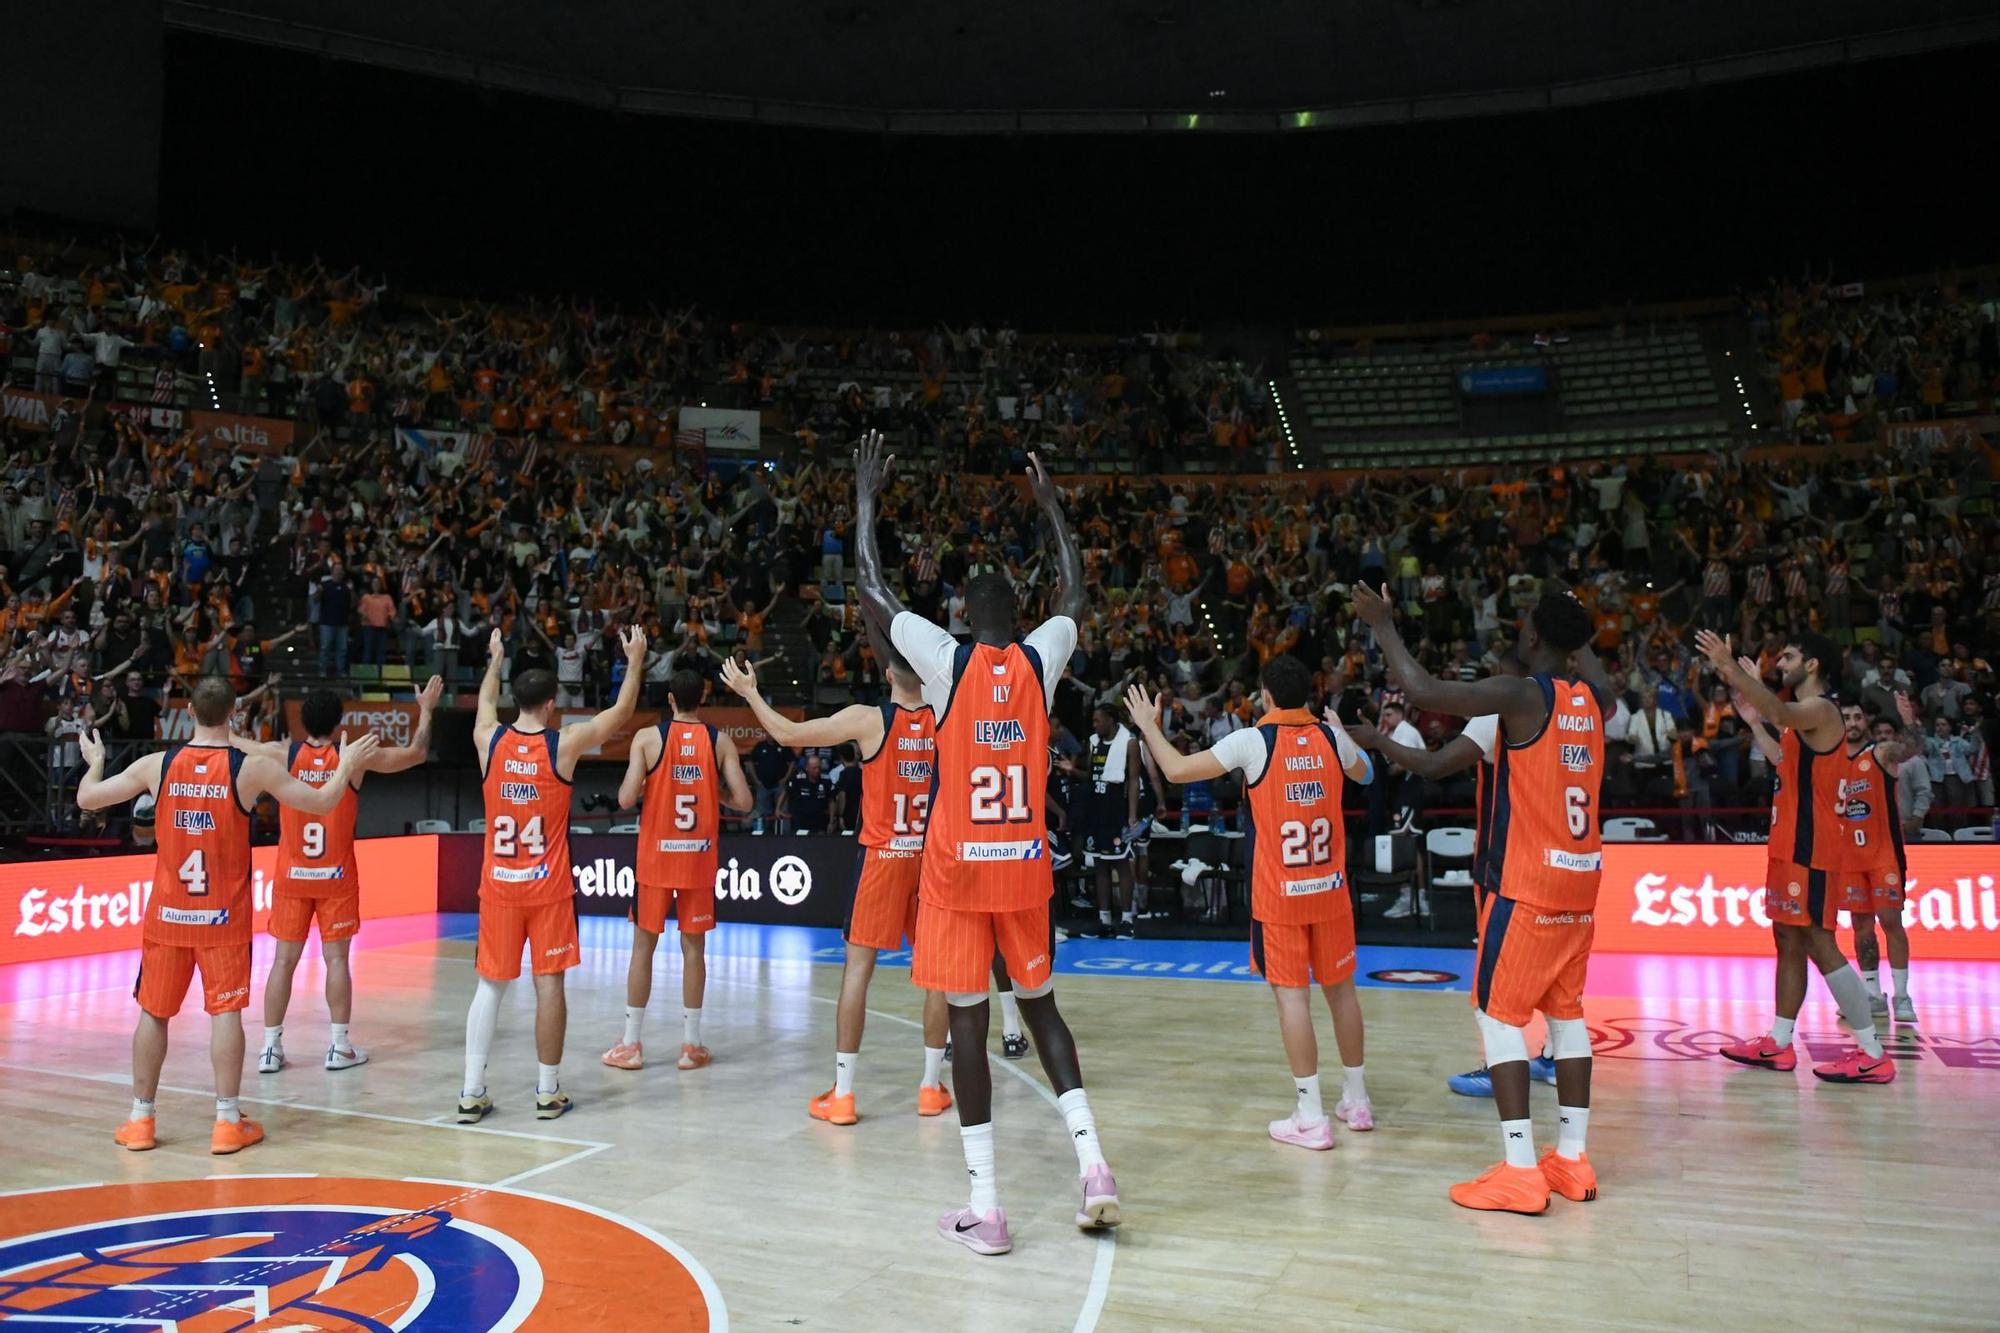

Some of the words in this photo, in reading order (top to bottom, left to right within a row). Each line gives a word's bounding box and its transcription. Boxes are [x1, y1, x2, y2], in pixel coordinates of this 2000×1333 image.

[993, 685, 1011, 703] ILY
[974, 720, 1026, 744] LEYMA
[680, 745, 695, 756] JOU
[504, 759, 537, 776] CREMO
[898, 760, 932, 778] LEYMA
[1285, 754, 1324, 771] VARELA
[168, 783, 228, 799] JORGENSEN
[501, 782, 540, 800] LEYMA
[970, 764, 1032, 825] 21
[1094, 781, 1107, 794] 35
[1285, 780, 1325, 802] LEYMA
[175, 810, 216, 831] LEYMA
[674, 794, 697, 831] 5
[893, 793, 929, 835] 13
[1565, 786, 1590, 839] 6
[303, 822, 325, 858] 9
[494, 816, 546, 857] 24
[1280, 818, 1332, 867] 22
[1854, 829, 1866, 846] 0
[664, 842, 696, 850] Aluman
[968, 847, 1017, 858] Aluman
[178, 849, 208, 896] 4
[294, 870, 328, 878] Aluman
[495, 870, 530, 879] Aluman
[1290, 881, 1328, 893] Aluman
[1631, 873, 1772, 927] Estre
[165, 911, 206, 922] Aluman
